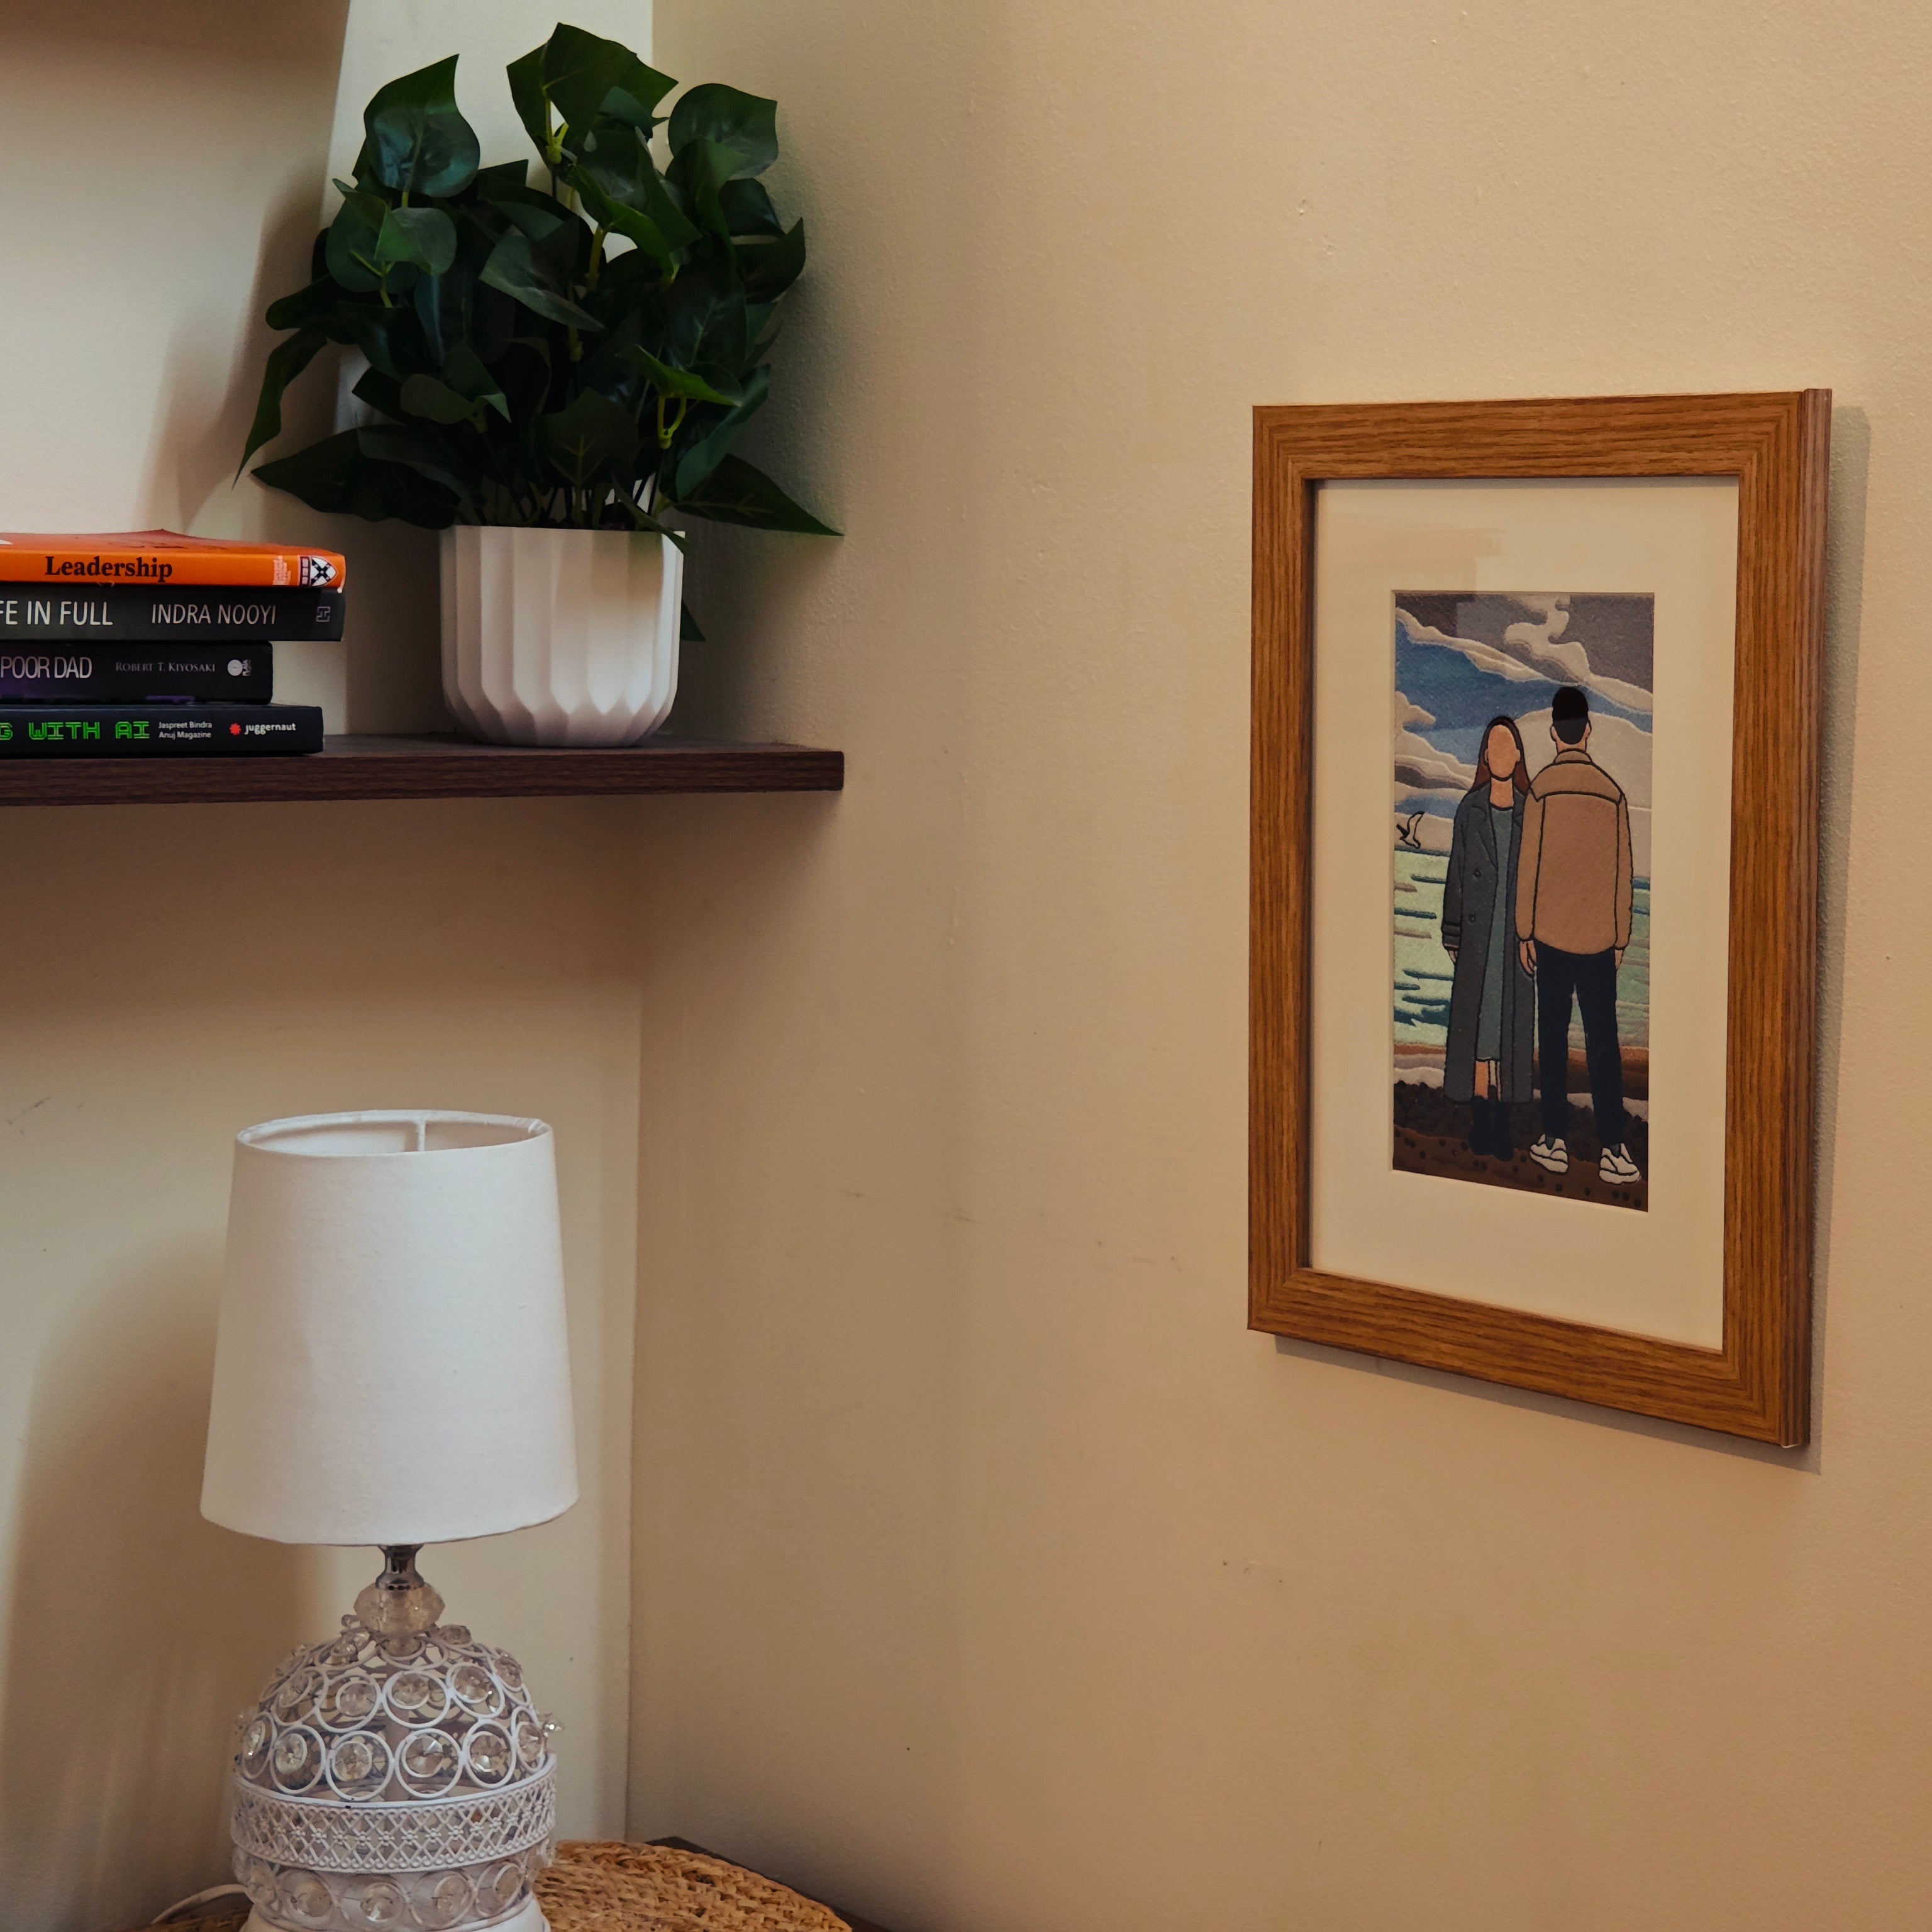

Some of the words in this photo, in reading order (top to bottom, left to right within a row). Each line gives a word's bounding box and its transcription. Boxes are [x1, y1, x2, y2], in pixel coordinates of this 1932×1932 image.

[45, 556, 173, 582] Leadership
[27, 600, 50, 625] IN
[60, 601, 113, 626] FULL
[152, 604, 211, 624] INDRA
[218, 604, 276, 625] NOOYI
[1, 656, 50, 679] POOR
[54, 656, 92, 679] DAD
[115, 662, 153, 672] ROBERT
[157, 662, 166, 672] T.
[169, 663, 216, 672] KIYOSAKI
[29, 722, 100, 740] WITH
[115, 721, 150, 739] AI
[158, 721, 187, 730] Jaspreet
[189, 721, 213, 729] Bindra
[244, 723, 296, 735] juggernaut
[158, 731, 176, 740] Anuj
[177, 731, 212, 740] Magazine
